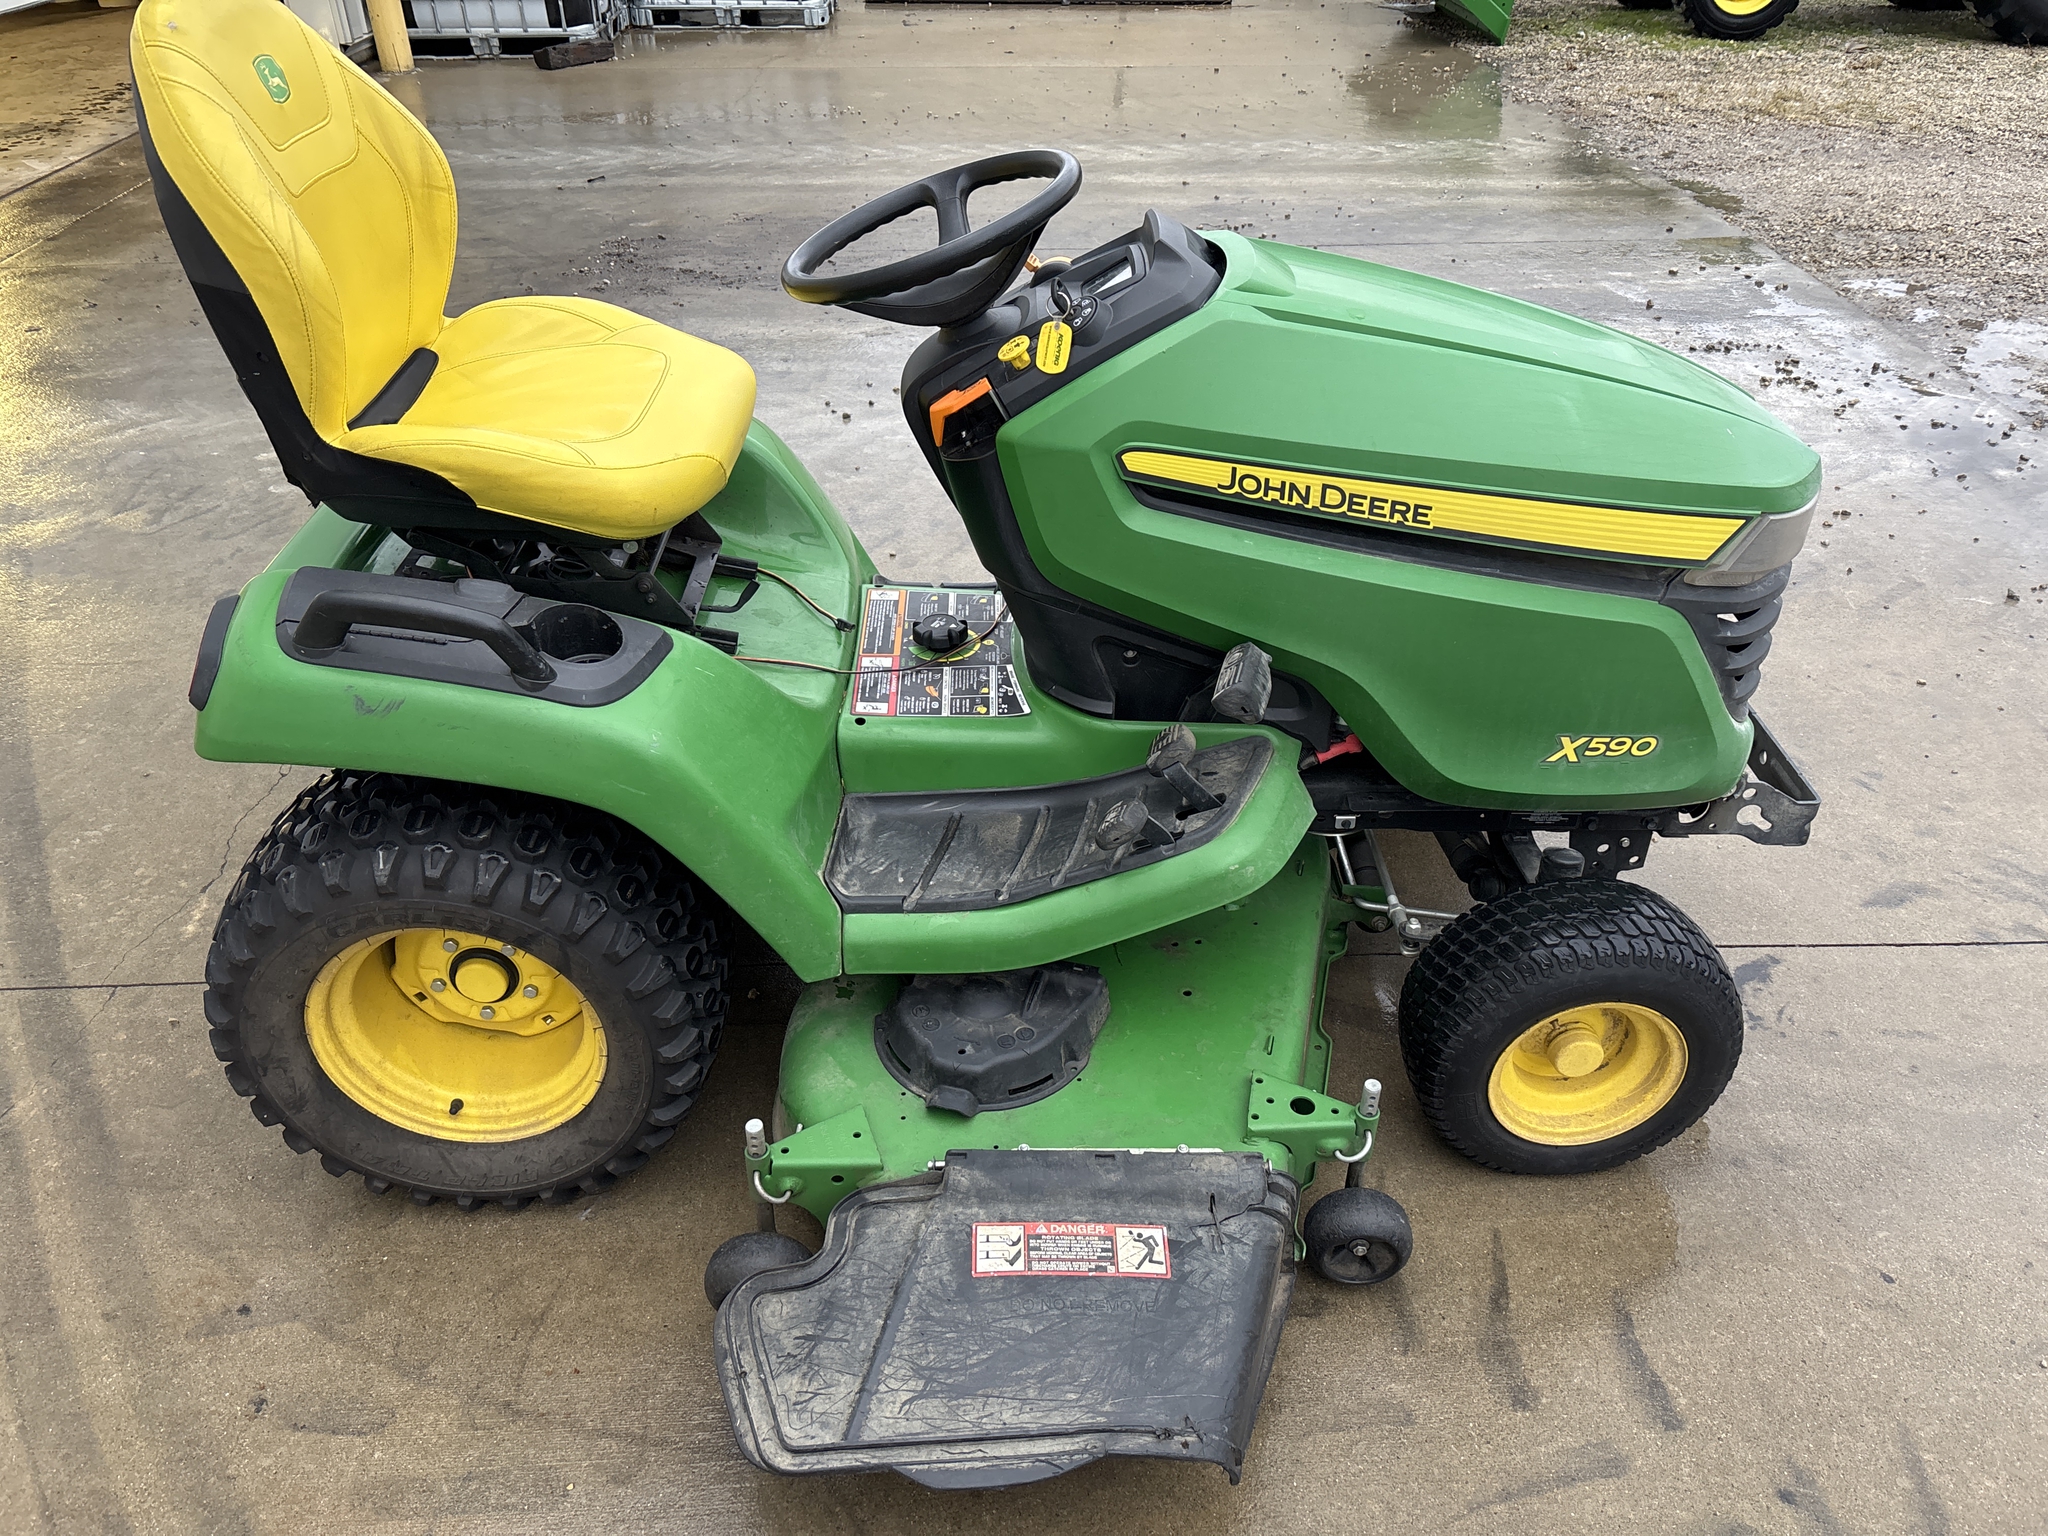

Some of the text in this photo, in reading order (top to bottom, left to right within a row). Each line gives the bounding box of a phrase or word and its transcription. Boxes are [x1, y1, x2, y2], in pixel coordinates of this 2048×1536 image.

[1217, 466, 1434, 526] JOHN DEERE
[1542, 736, 1658, 763] X590
[1050, 1224, 1105, 1234] DANGER
